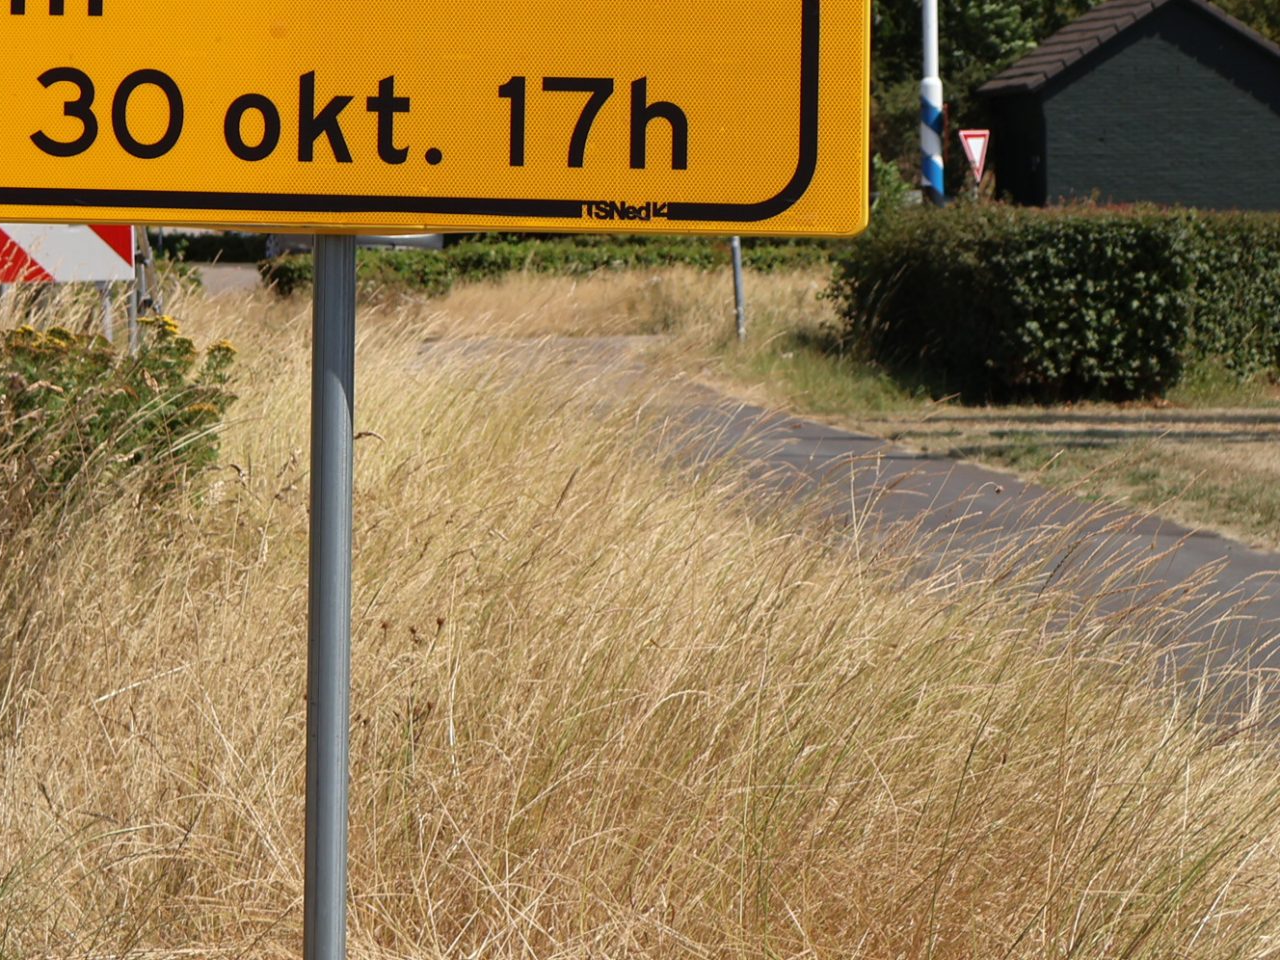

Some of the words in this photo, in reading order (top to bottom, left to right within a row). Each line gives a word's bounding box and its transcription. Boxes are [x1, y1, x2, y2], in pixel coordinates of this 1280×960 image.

[29, 66, 185, 160] 30
[223, 70, 443, 166] okt.
[498, 75, 689, 171] 17h
